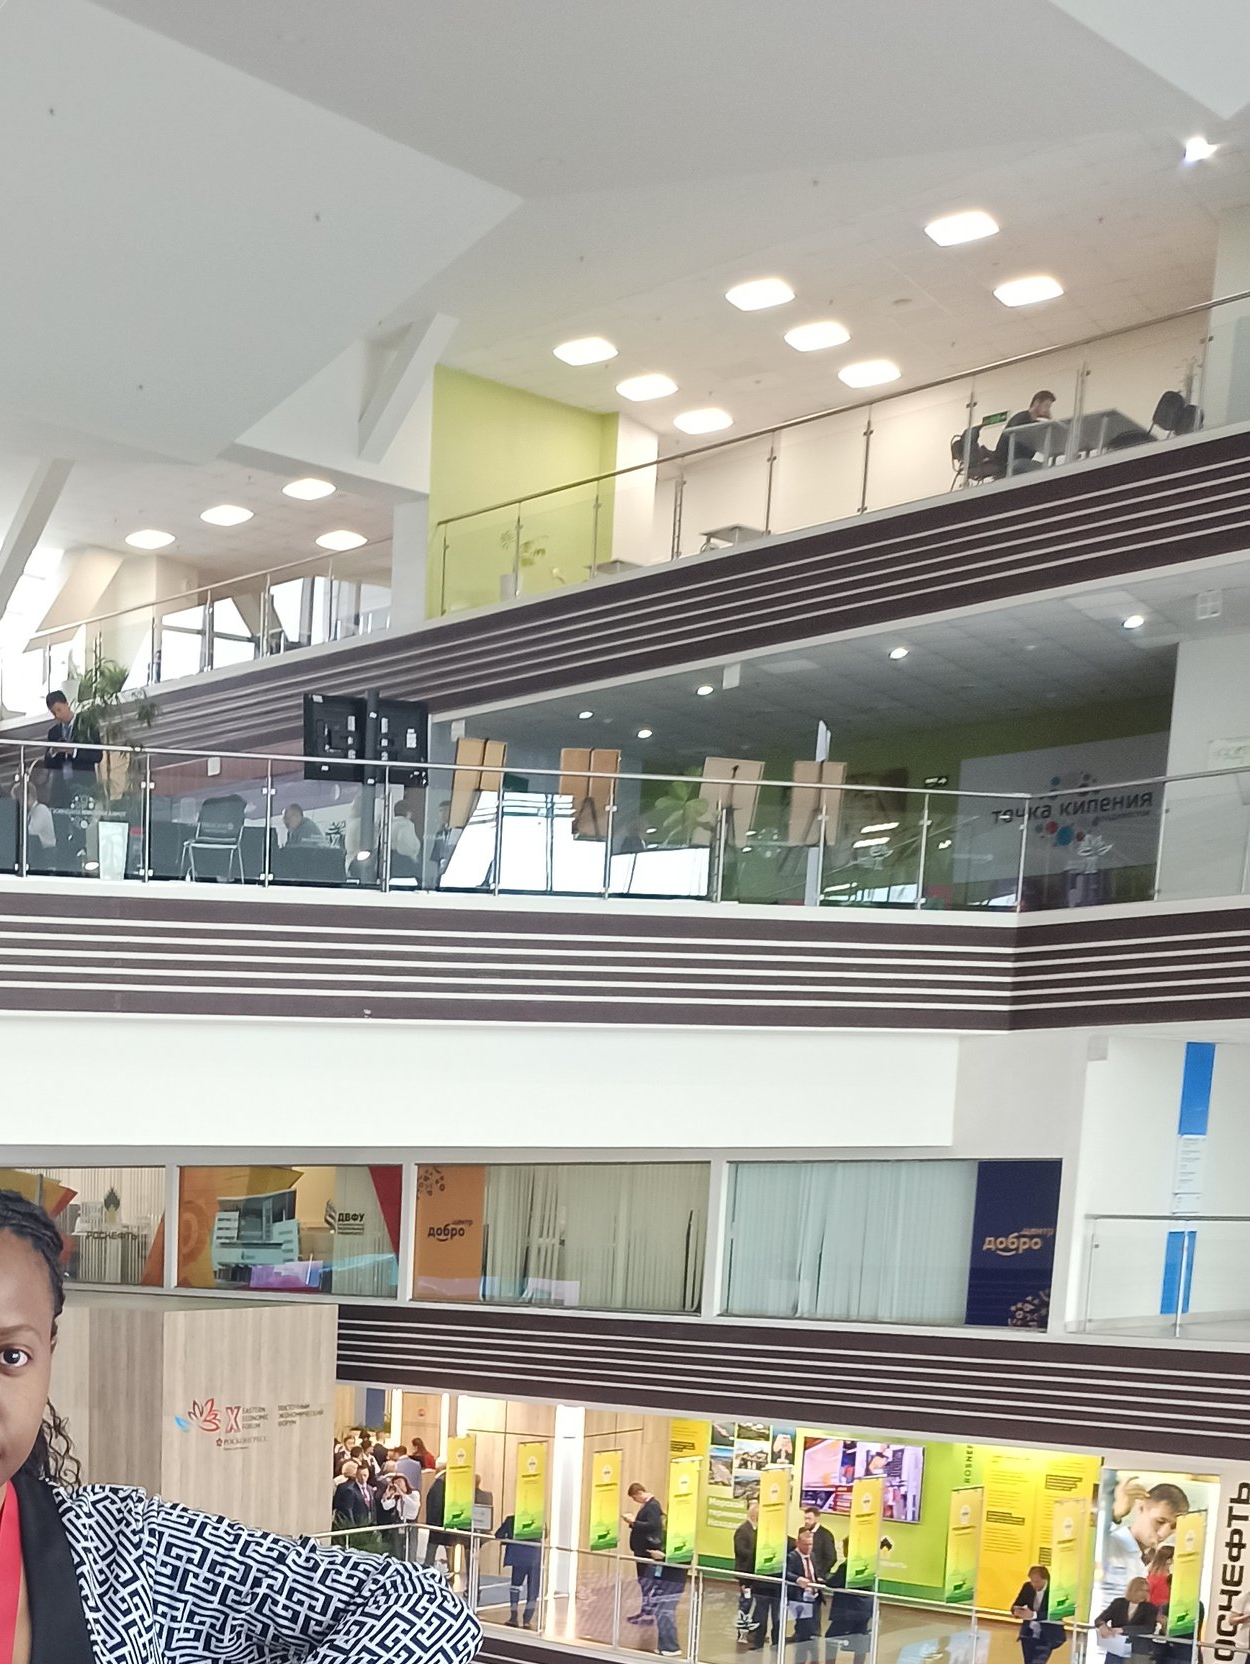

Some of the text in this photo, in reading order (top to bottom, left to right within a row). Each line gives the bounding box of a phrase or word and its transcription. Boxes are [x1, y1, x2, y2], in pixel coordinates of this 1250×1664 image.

[991, 791, 1153, 824] точка кипения
[338, 1212, 365, 1222] ДВФУ
[428, 1223, 465, 1241] добро
[982, 1232, 1042, 1255] добро
